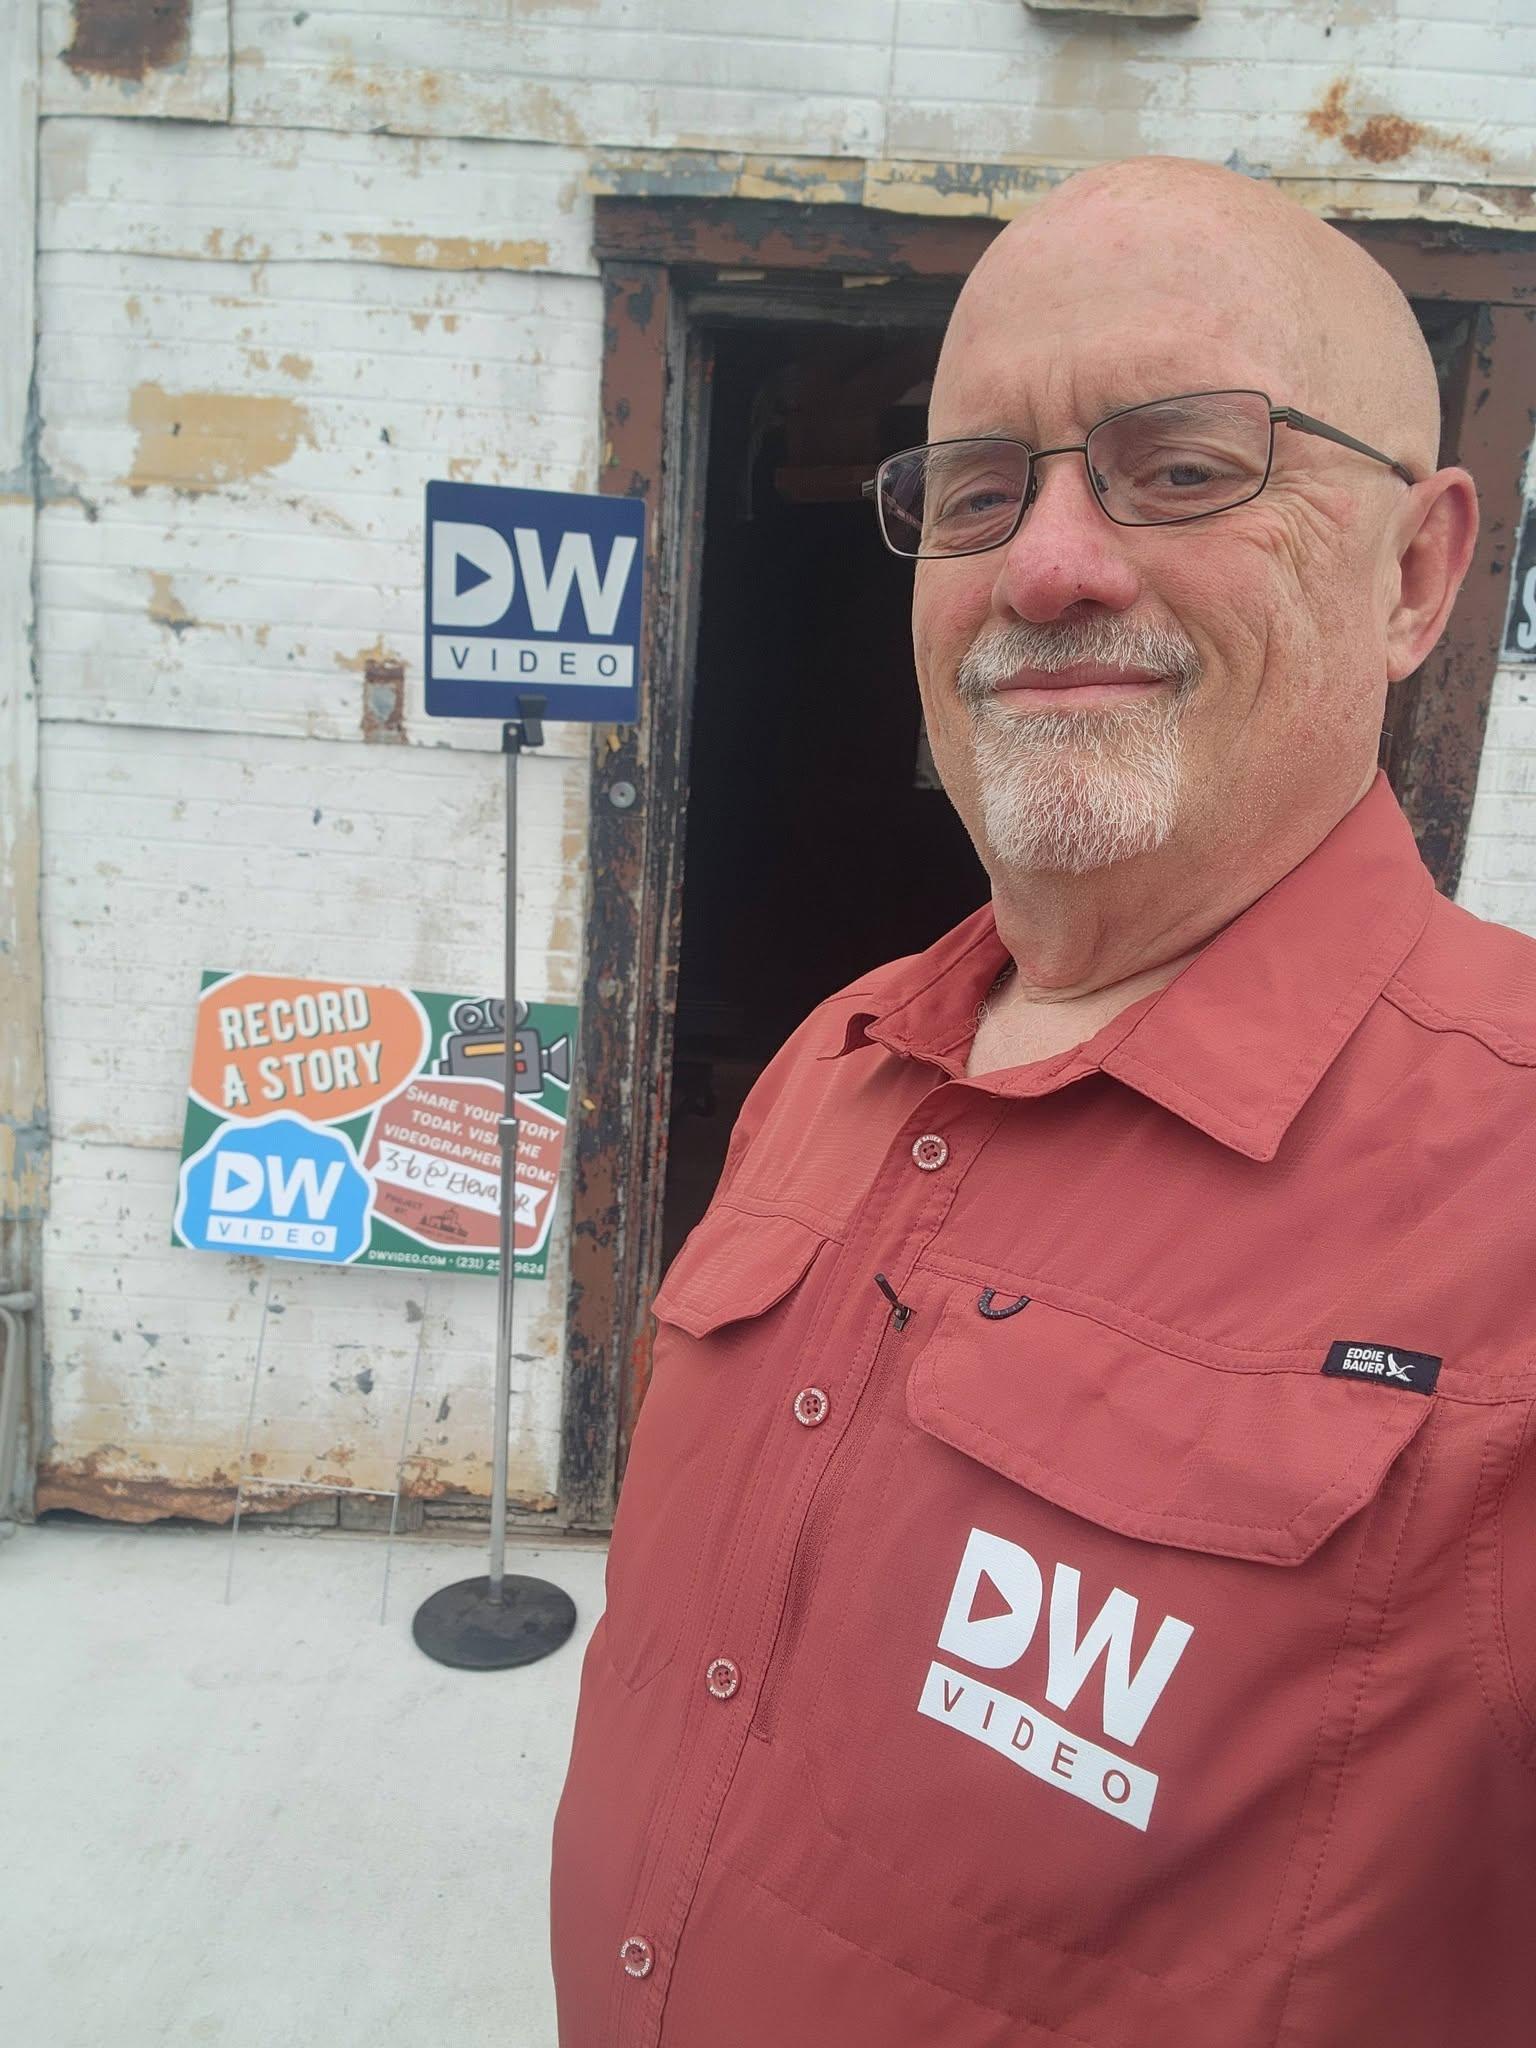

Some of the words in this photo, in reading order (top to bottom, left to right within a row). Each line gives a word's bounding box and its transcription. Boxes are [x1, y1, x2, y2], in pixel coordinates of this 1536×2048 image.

[431, 520, 638, 636] DW
[450, 646, 617, 676] VIDEO
[218, 986, 371, 1051] RECORD
[221, 1064, 249, 1108] A
[258, 1039, 383, 1101] STORY
[406, 1085, 459, 1113] SHARE
[519, 1119, 560, 1142] TORY
[469, 1126, 499, 1146] VISI
[384, 1123, 502, 1168] VIDEOGRAPHER
[515, 1161, 556, 1184] ROM:
[210, 1150, 346, 1221] DW
[219, 1222, 327, 1246] VIDEO
[368, 1250, 446, 1266] DWVIDEO.COM
[455, 1257, 485, 1270] (231)
[1342, 1358, 1385, 1375] BAUER
[1346, 1347, 1385, 1362] EDDIE
[936, 1527, 1195, 1747] DW
[940, 1679, 1132, 1804] VIDEO
